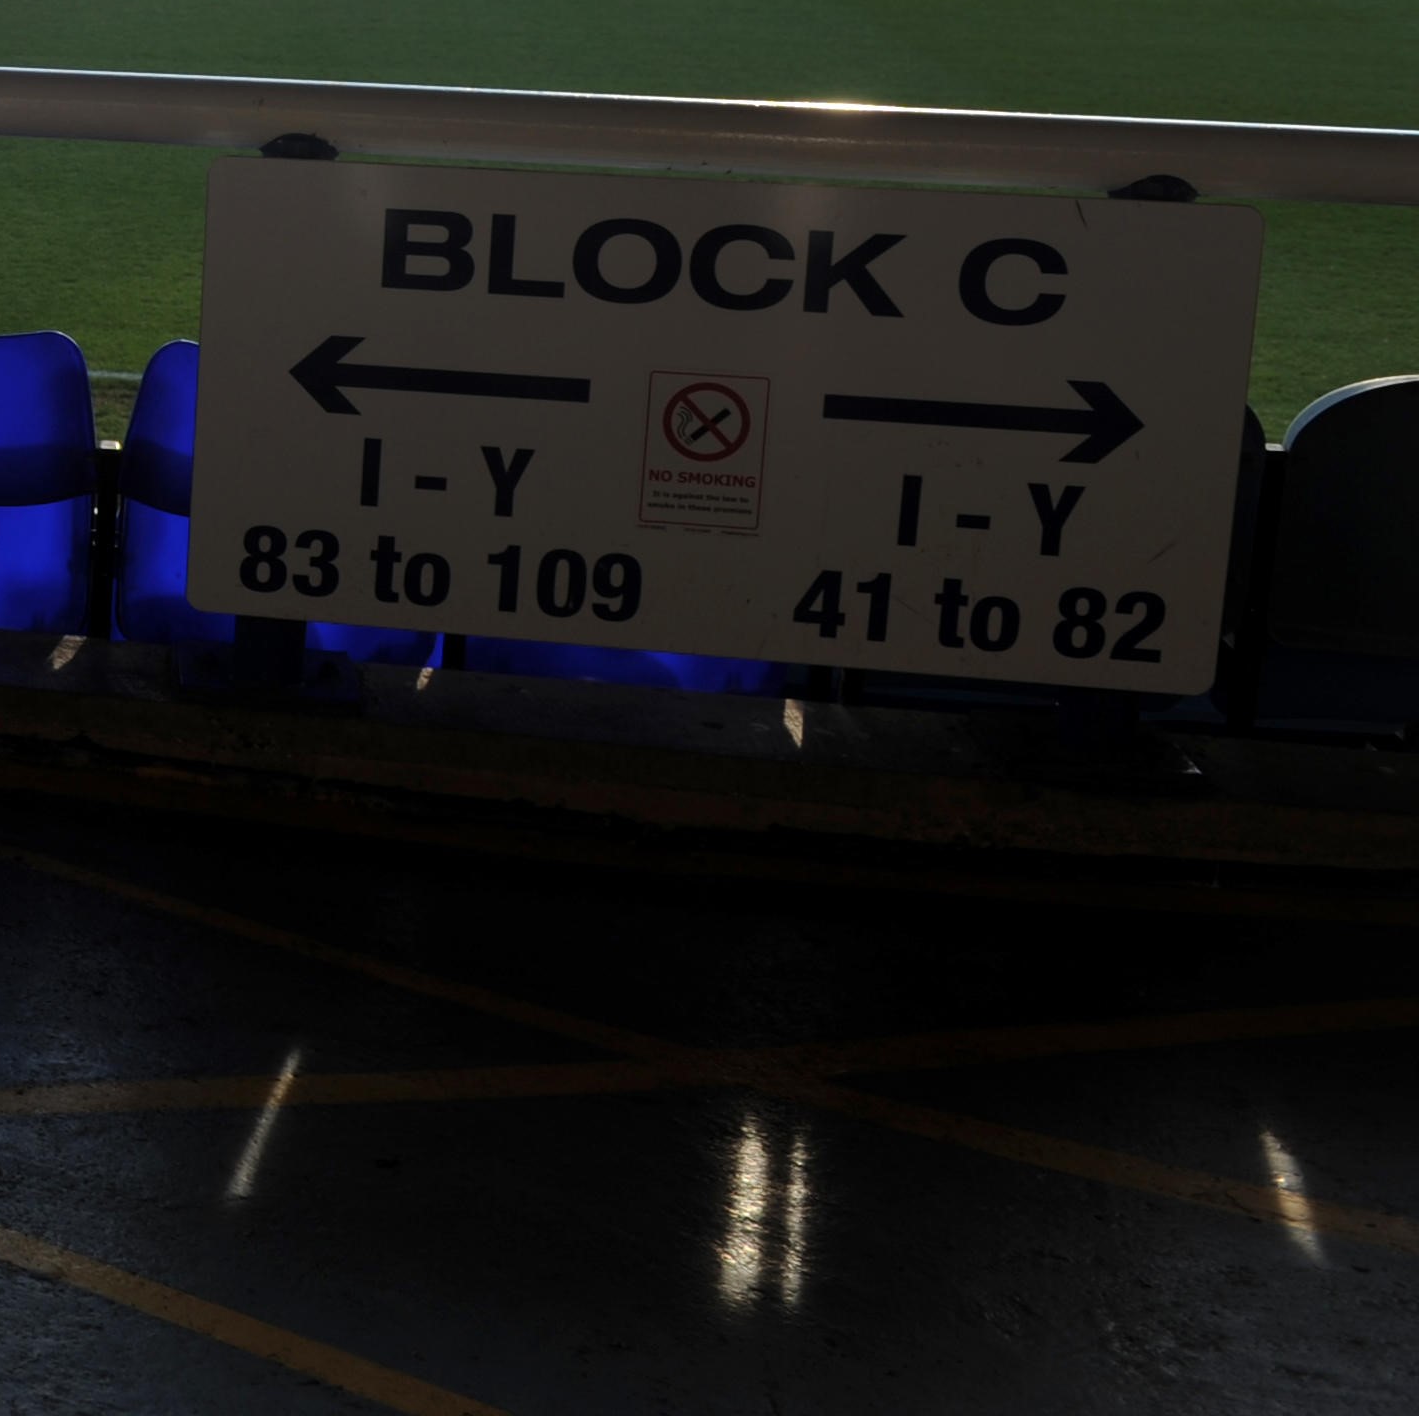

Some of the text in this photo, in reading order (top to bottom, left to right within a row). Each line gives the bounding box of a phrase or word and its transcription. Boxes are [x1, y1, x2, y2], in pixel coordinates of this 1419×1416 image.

[379, 207, 1070, 327] BLOCK C
[479, 445, 536, 518] Y
[648, 468, 756, 488] NO SMOKING
[1026, 482, 1087, 557] Y
[238, 524, 643, 623] 83 to 109
[792, 569, 1167, 664] 41 to 82
